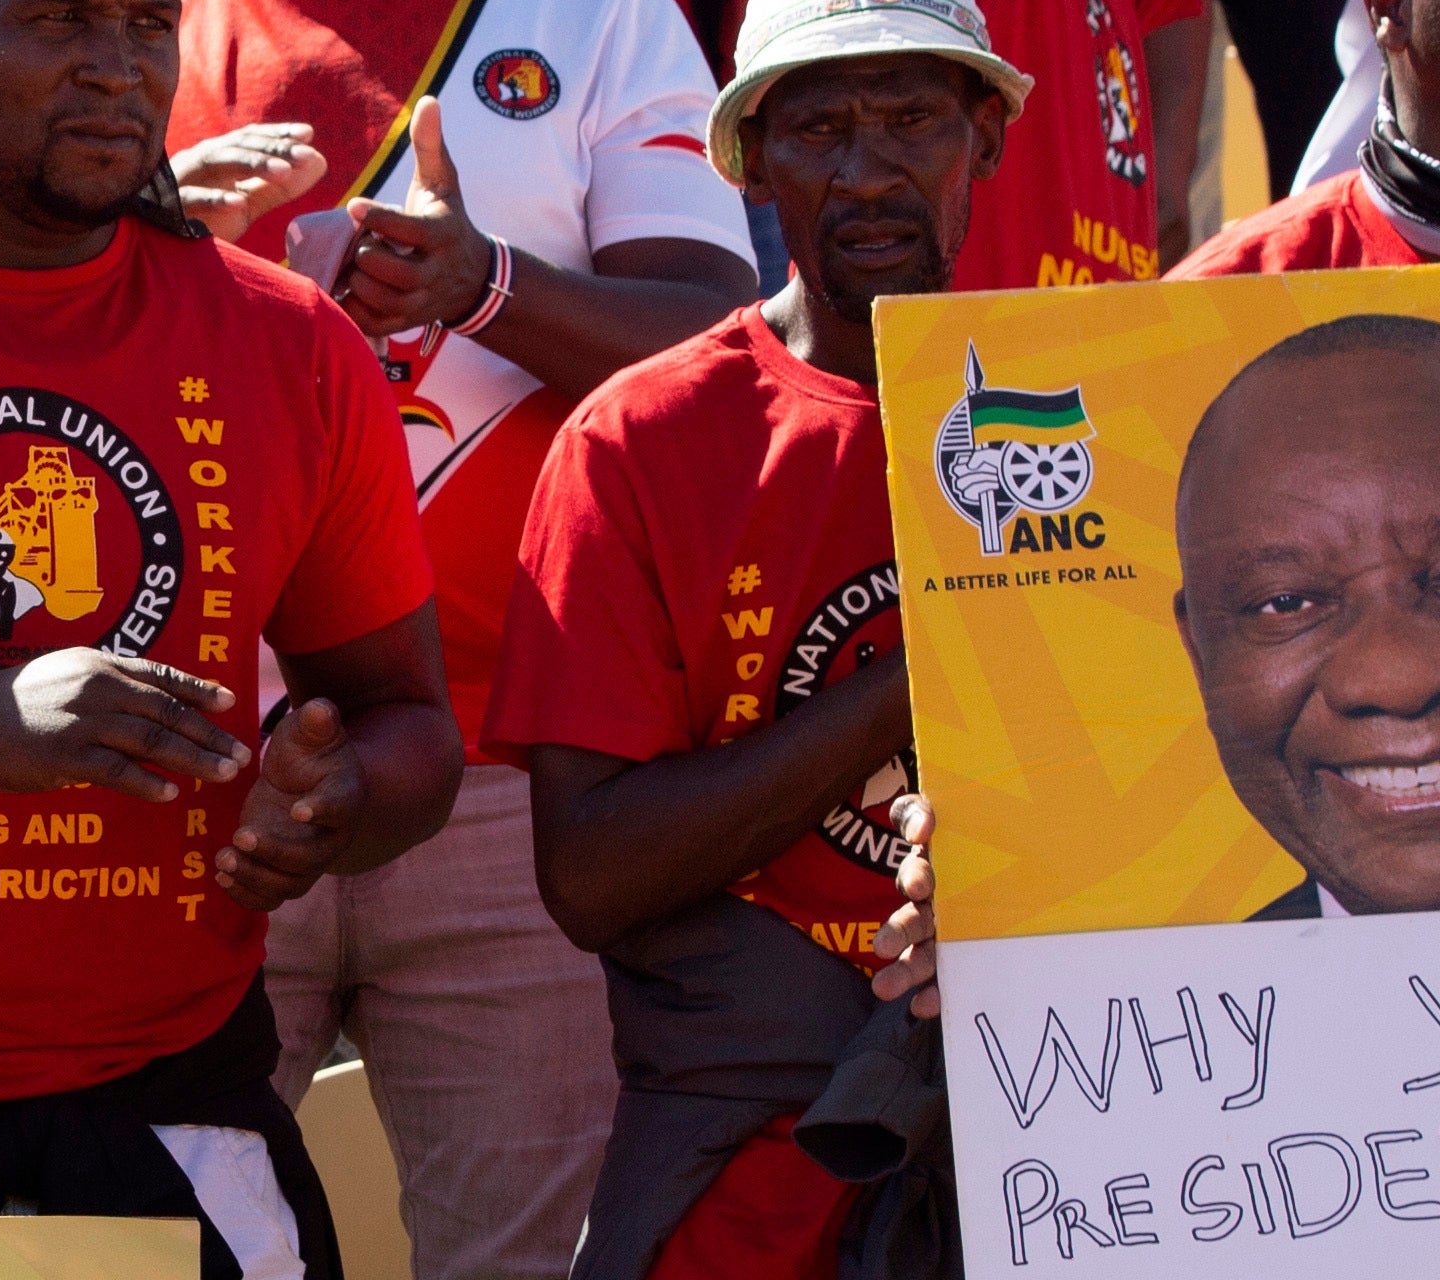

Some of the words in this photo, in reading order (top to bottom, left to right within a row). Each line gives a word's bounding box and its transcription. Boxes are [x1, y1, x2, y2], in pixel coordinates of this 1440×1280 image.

[60, 405, 168, 520] UNION
[924, 577, 938, 593] A
[944, 572, 1008, 591] BETTER
[1016, 569, 1051, 586] LIFE
[1058, 567, 1097, 583] FOR
[1104, 564, 1137, 581] ALL
[1009, 511, 1106, 555] ANC
[106, 563, 176, 661] KERS
[783, 567, 899, 697] NATION
[22, 814, 103, 844] AND
[975, 986, 1276, 1129] WHY
